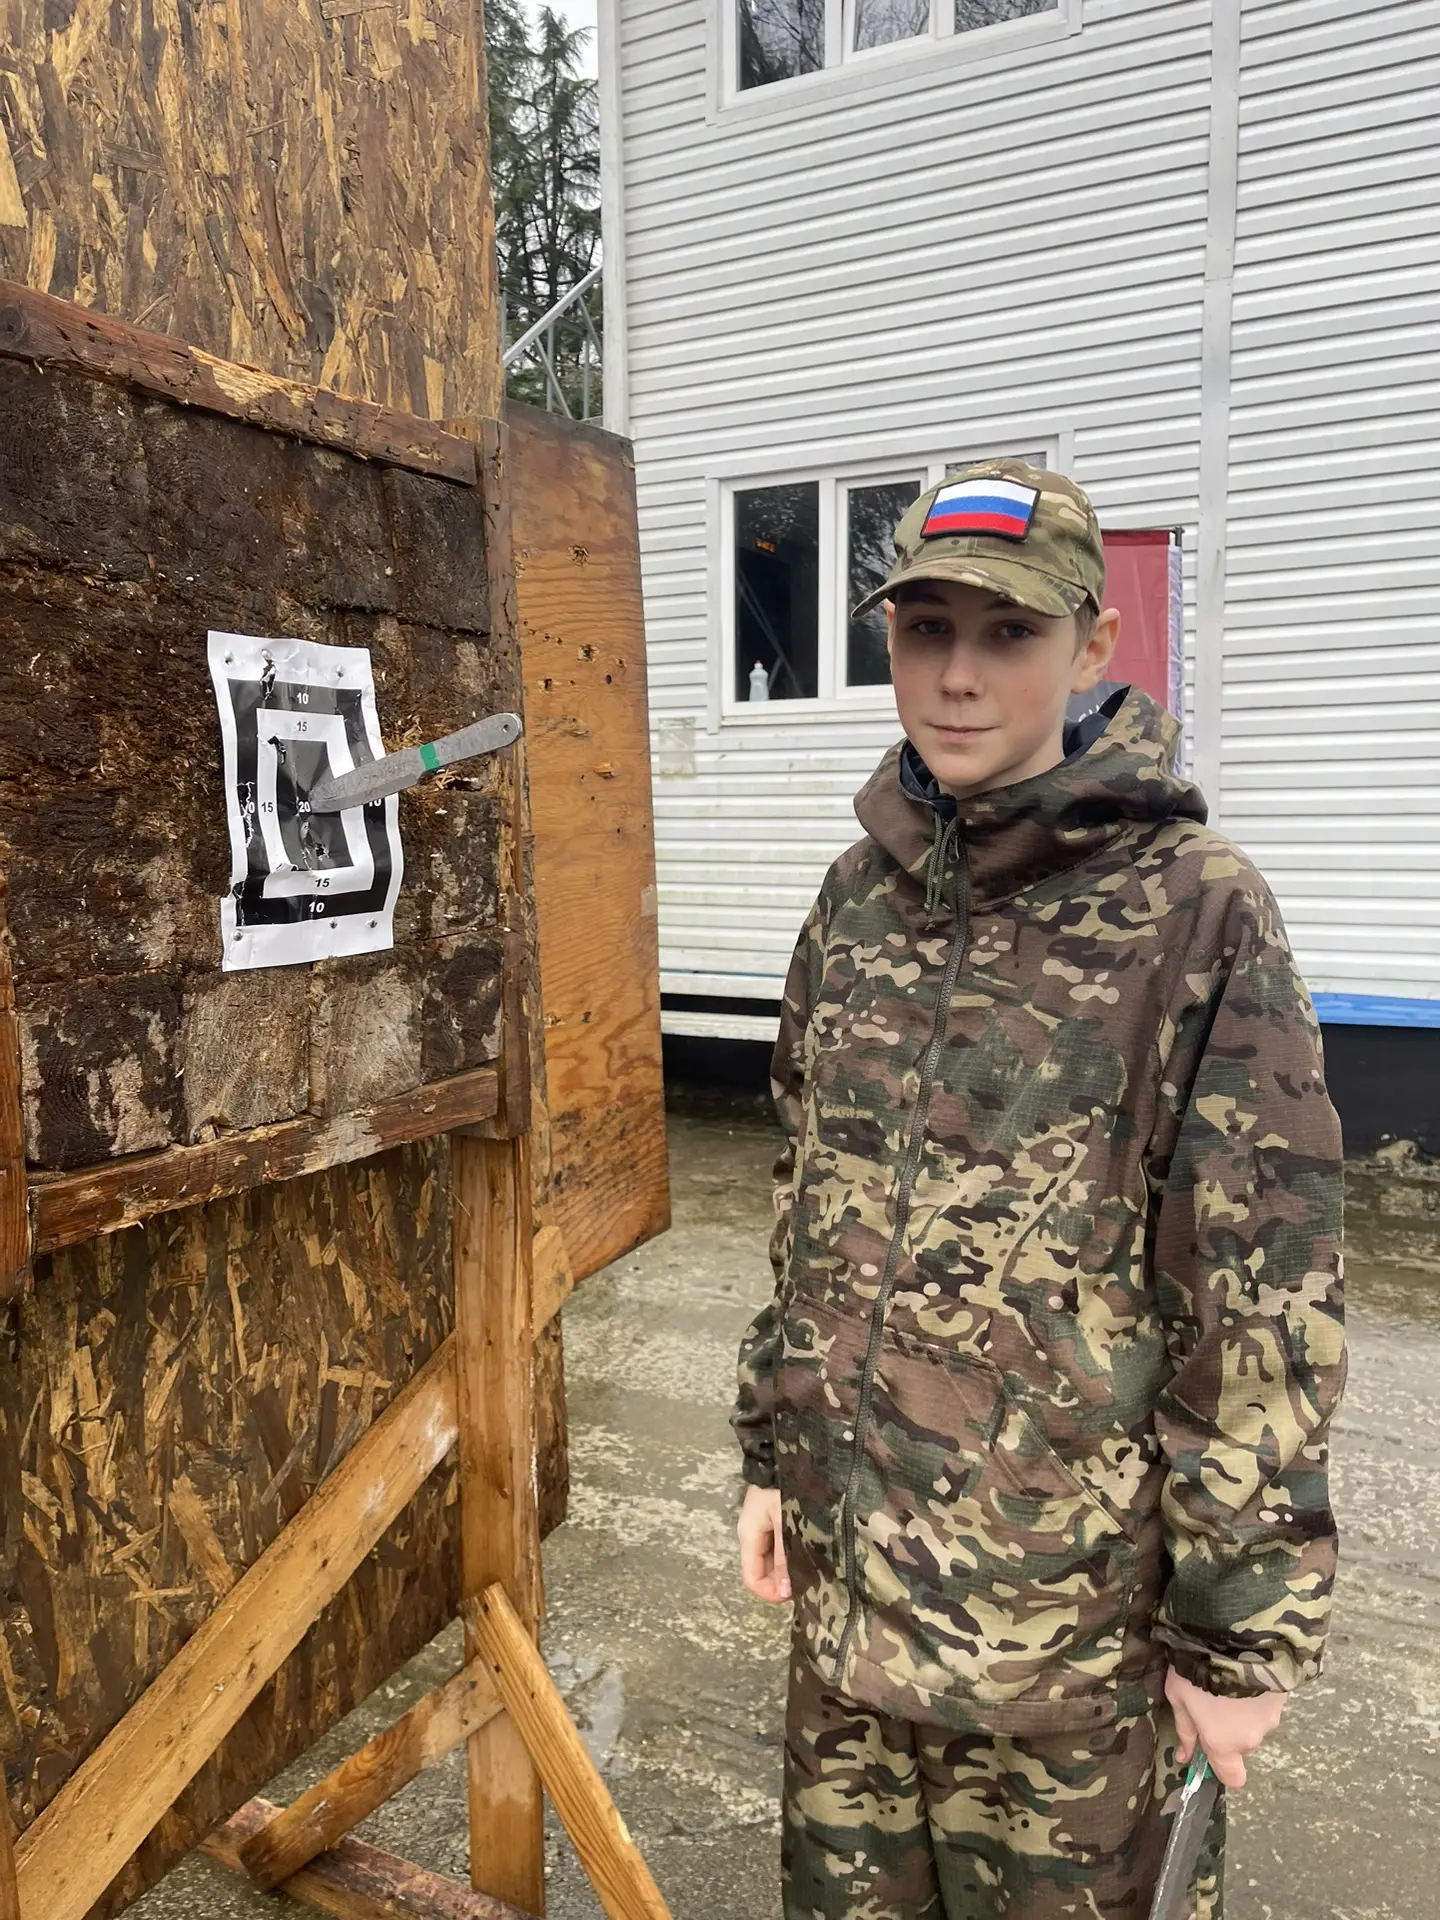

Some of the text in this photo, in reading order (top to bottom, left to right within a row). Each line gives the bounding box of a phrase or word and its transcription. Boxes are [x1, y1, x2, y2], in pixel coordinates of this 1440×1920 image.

[297, 692, 309, 704] 10
[297, 721, 308, 732] 15
[261, 801, 274, 813] 15
[298, 801, 311, 813] 20
[315, 878, 330, 888] 15
[309, 901, 325, 913] 10
